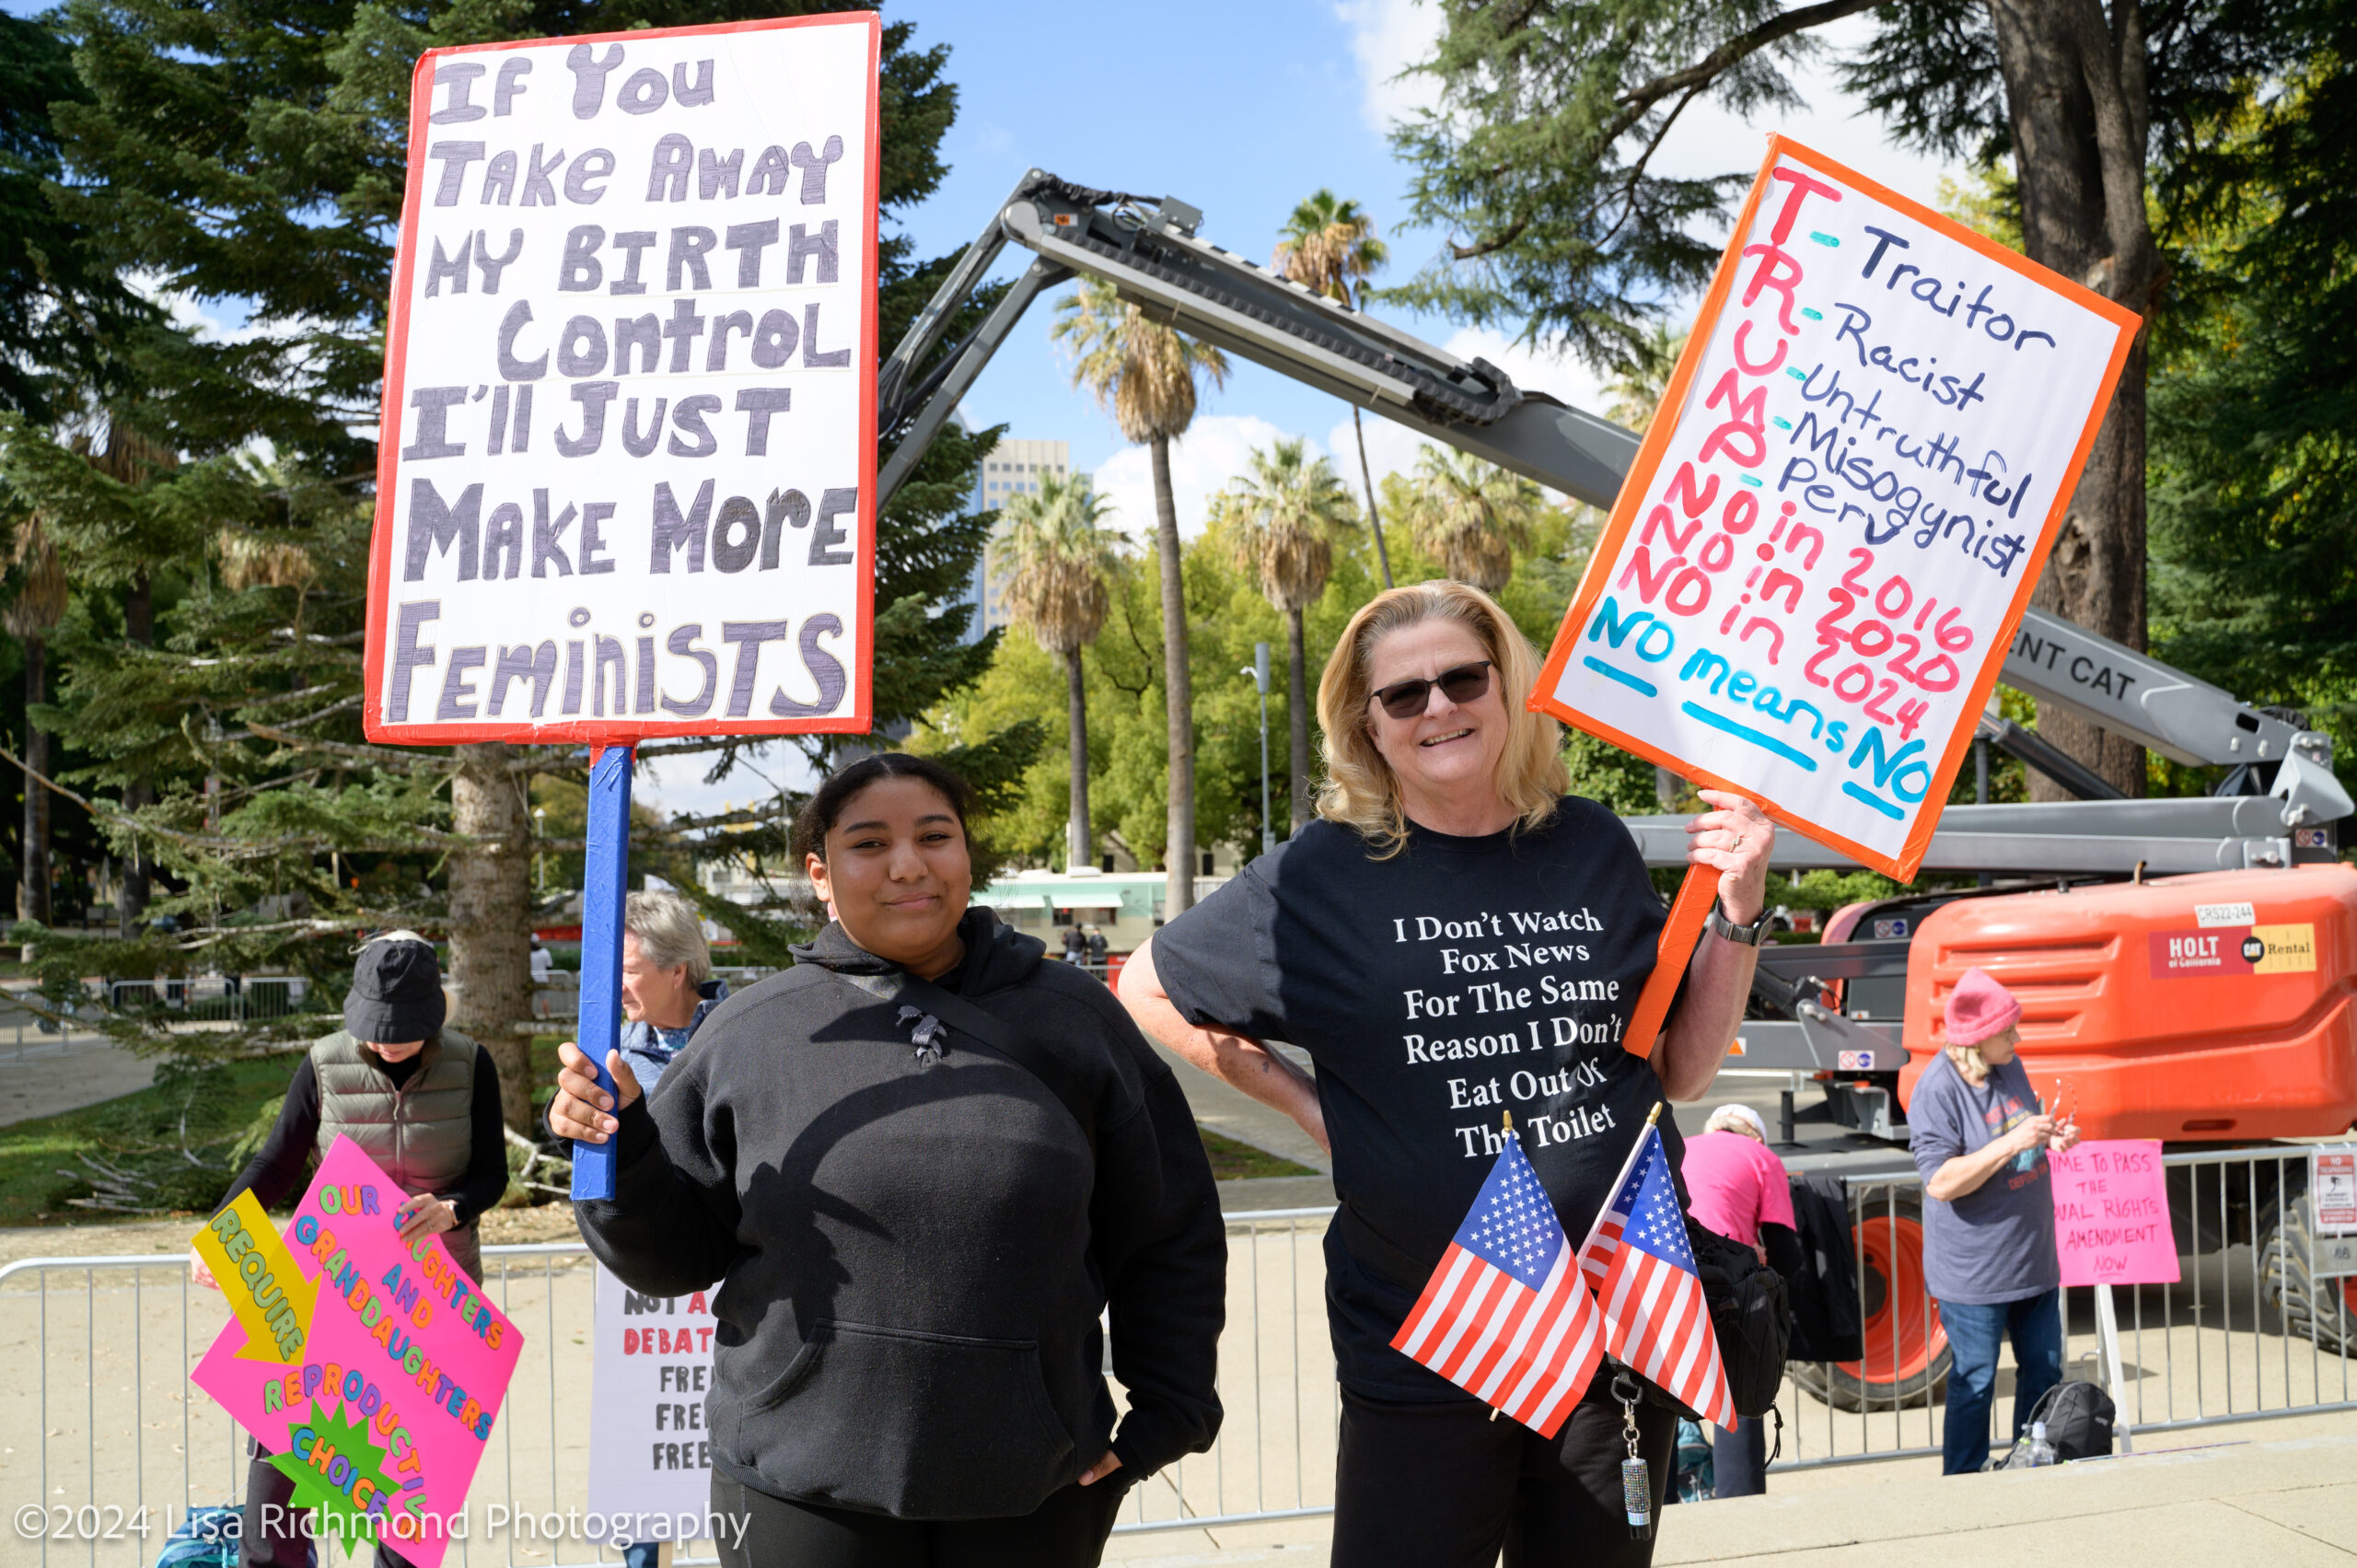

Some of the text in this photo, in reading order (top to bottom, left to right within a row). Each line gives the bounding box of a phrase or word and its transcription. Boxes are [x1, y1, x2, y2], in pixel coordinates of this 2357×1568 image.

[424, 217, 839, 298] MY BIRTH
[1864, 225, 2057, 352] Traitor
[1834, 301, 1986, 412] Racist
[1800, 363, 2032, 518] Untruthful
[1789, 411, 2026, 578] Misogynist
[403, 477, 617, 583] MAKE
[1768, 500, 1825, 571] in
[1840, 546, 1975, 654] 2016
[1745, 541, 1805, 614] in
[1815, 587, 1962, 693] 2020
[1719, 592, 1785, 665] in
[1804, 633, 1931, 741] 2024
[2009, 628, 2136, 701] NT CAT
[1678, 647, 1850, 753] means
[1392, 907, 1605, 943] I Don't Watch
[2198, 905, 2253, 922] CRS22-244
[1440, 943, 1591, 974] Fox News
[2168, 935, 2220, 958] HOLT
[2179, 957, 2222, 969] California
[2243, 942, 2311, 957] CAT Rental
[1403, 975, 1620, 1020] For The Same
[1402, 1013, 1622, 1065] Reason I Don't
[1446, 1077, 1504, 1109] Eat
[1510, 1066, 1573, 1102] Out
[1527, 1103, 1618, 1148] Toilet
[2090, 1153, 2109, 1174] TO
[2112, 1152, 2153, 1174] PASS
[319, 1184, 383, 1217] OUR
[2075, 1179, 2107, 1195] THE
[2064, 1223, 2159, 1252] AMENDMENT
[210, 1207, 306, 1363] REQUIRE
[393, 1201, 504, 1352] UGHTERS
[2094, 1255, 2129, 1273] NOW
[381, 1263, 434, 1330] AND
[687, 1290, 708, 1315] A
[295, 1214, 493, 1443] GRANDDAUGHTERS
[623, 1327, 714, 1356] DEBAT
[660, 1365, 714, 1393] FRE
[656, 1402, 709, 1432] FRE
[292, 1426, 389, 1526] CHOICE
